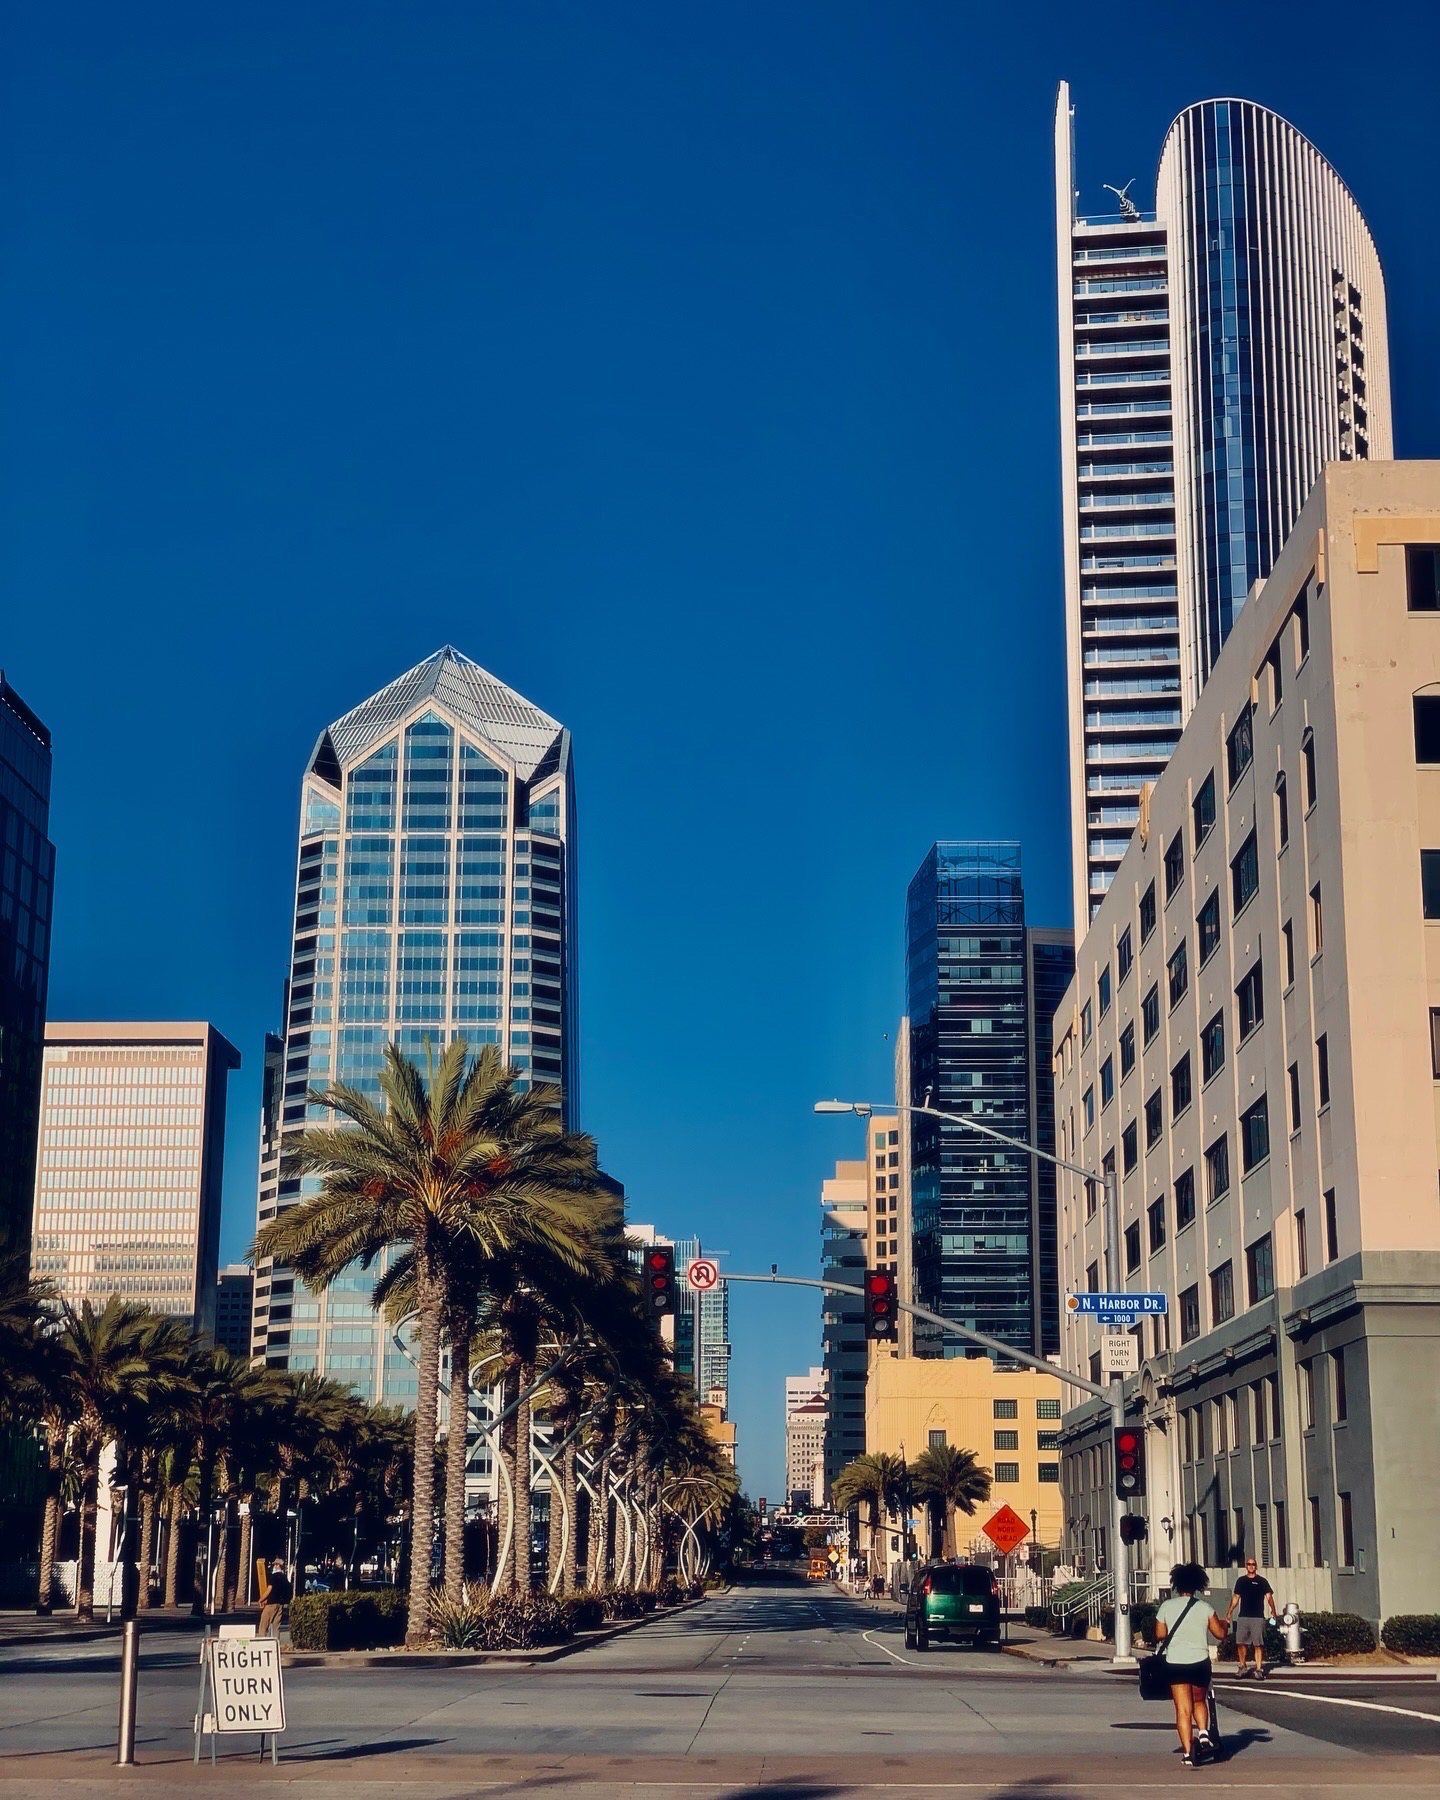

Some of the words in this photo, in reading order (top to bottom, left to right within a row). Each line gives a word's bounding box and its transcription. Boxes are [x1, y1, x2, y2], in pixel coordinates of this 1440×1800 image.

[1082, 1298, 1095, 1309] N.
[1114, 1314, 1131, 1323] 1000
[1110, 1349, 1130, 1357] TURN
[217, 1650, 272, 1668] RIGHT
[222, 1677, 273, 1695] TURN
[225, 1703, 273, 1722] ONLY
